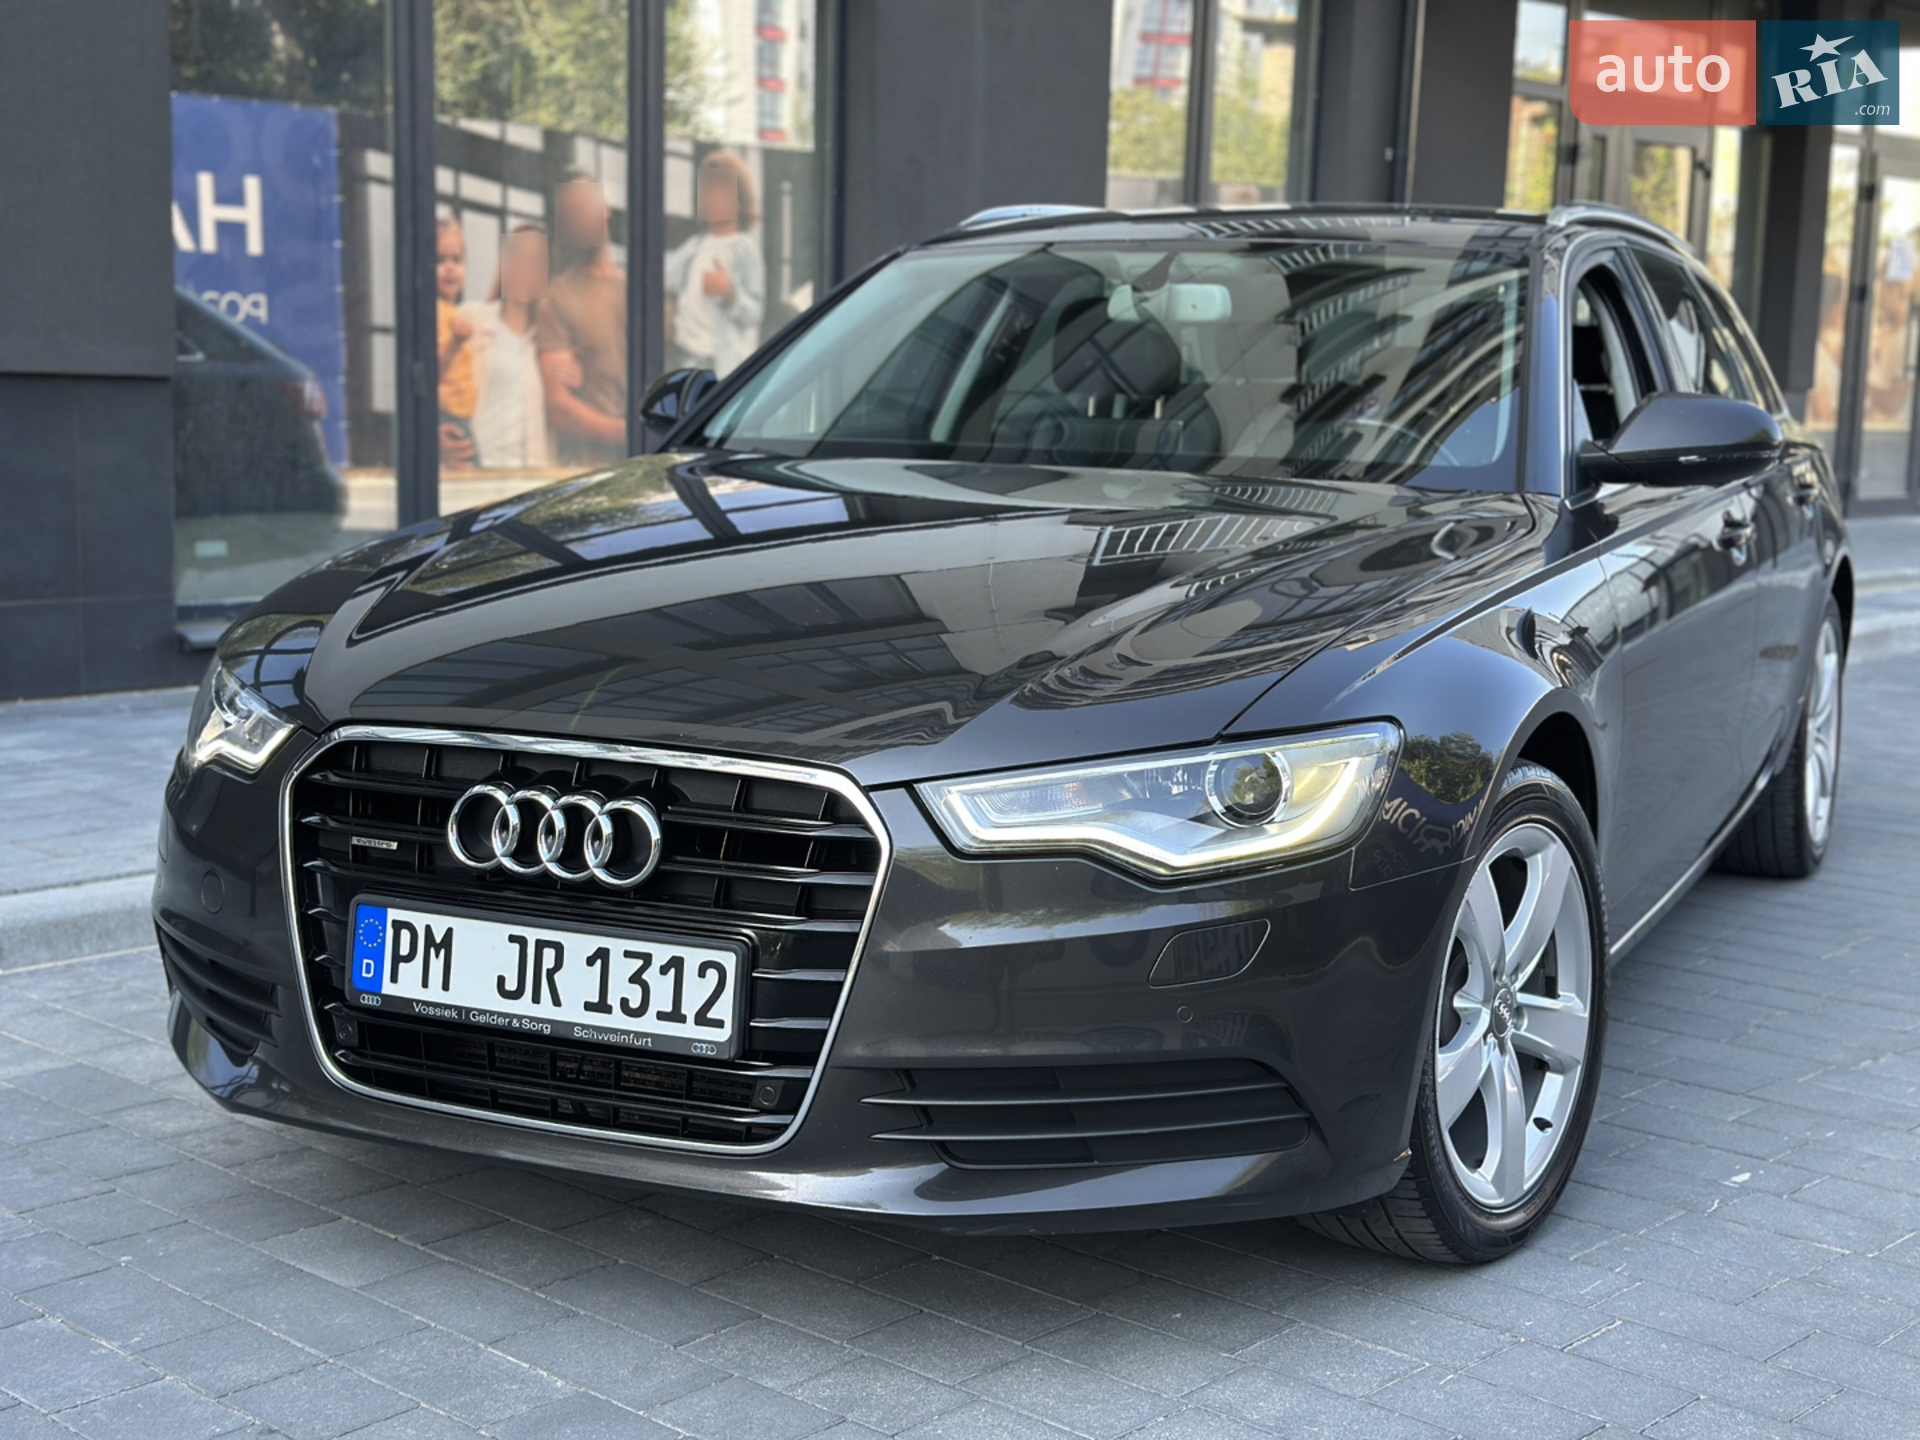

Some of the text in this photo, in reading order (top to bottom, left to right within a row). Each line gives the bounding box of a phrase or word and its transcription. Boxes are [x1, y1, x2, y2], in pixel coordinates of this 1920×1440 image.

[362, 958, 375, 979] D
[389, 918, 727, 1030] PM JR 1312
[412, 1001, 459, 1019] Vossiek
[469, 1010, 510, 1027] Gelder
[521, 1018, 552, 1035] Sorg
[573, 1026, 652, 1048] Schweinfurt
